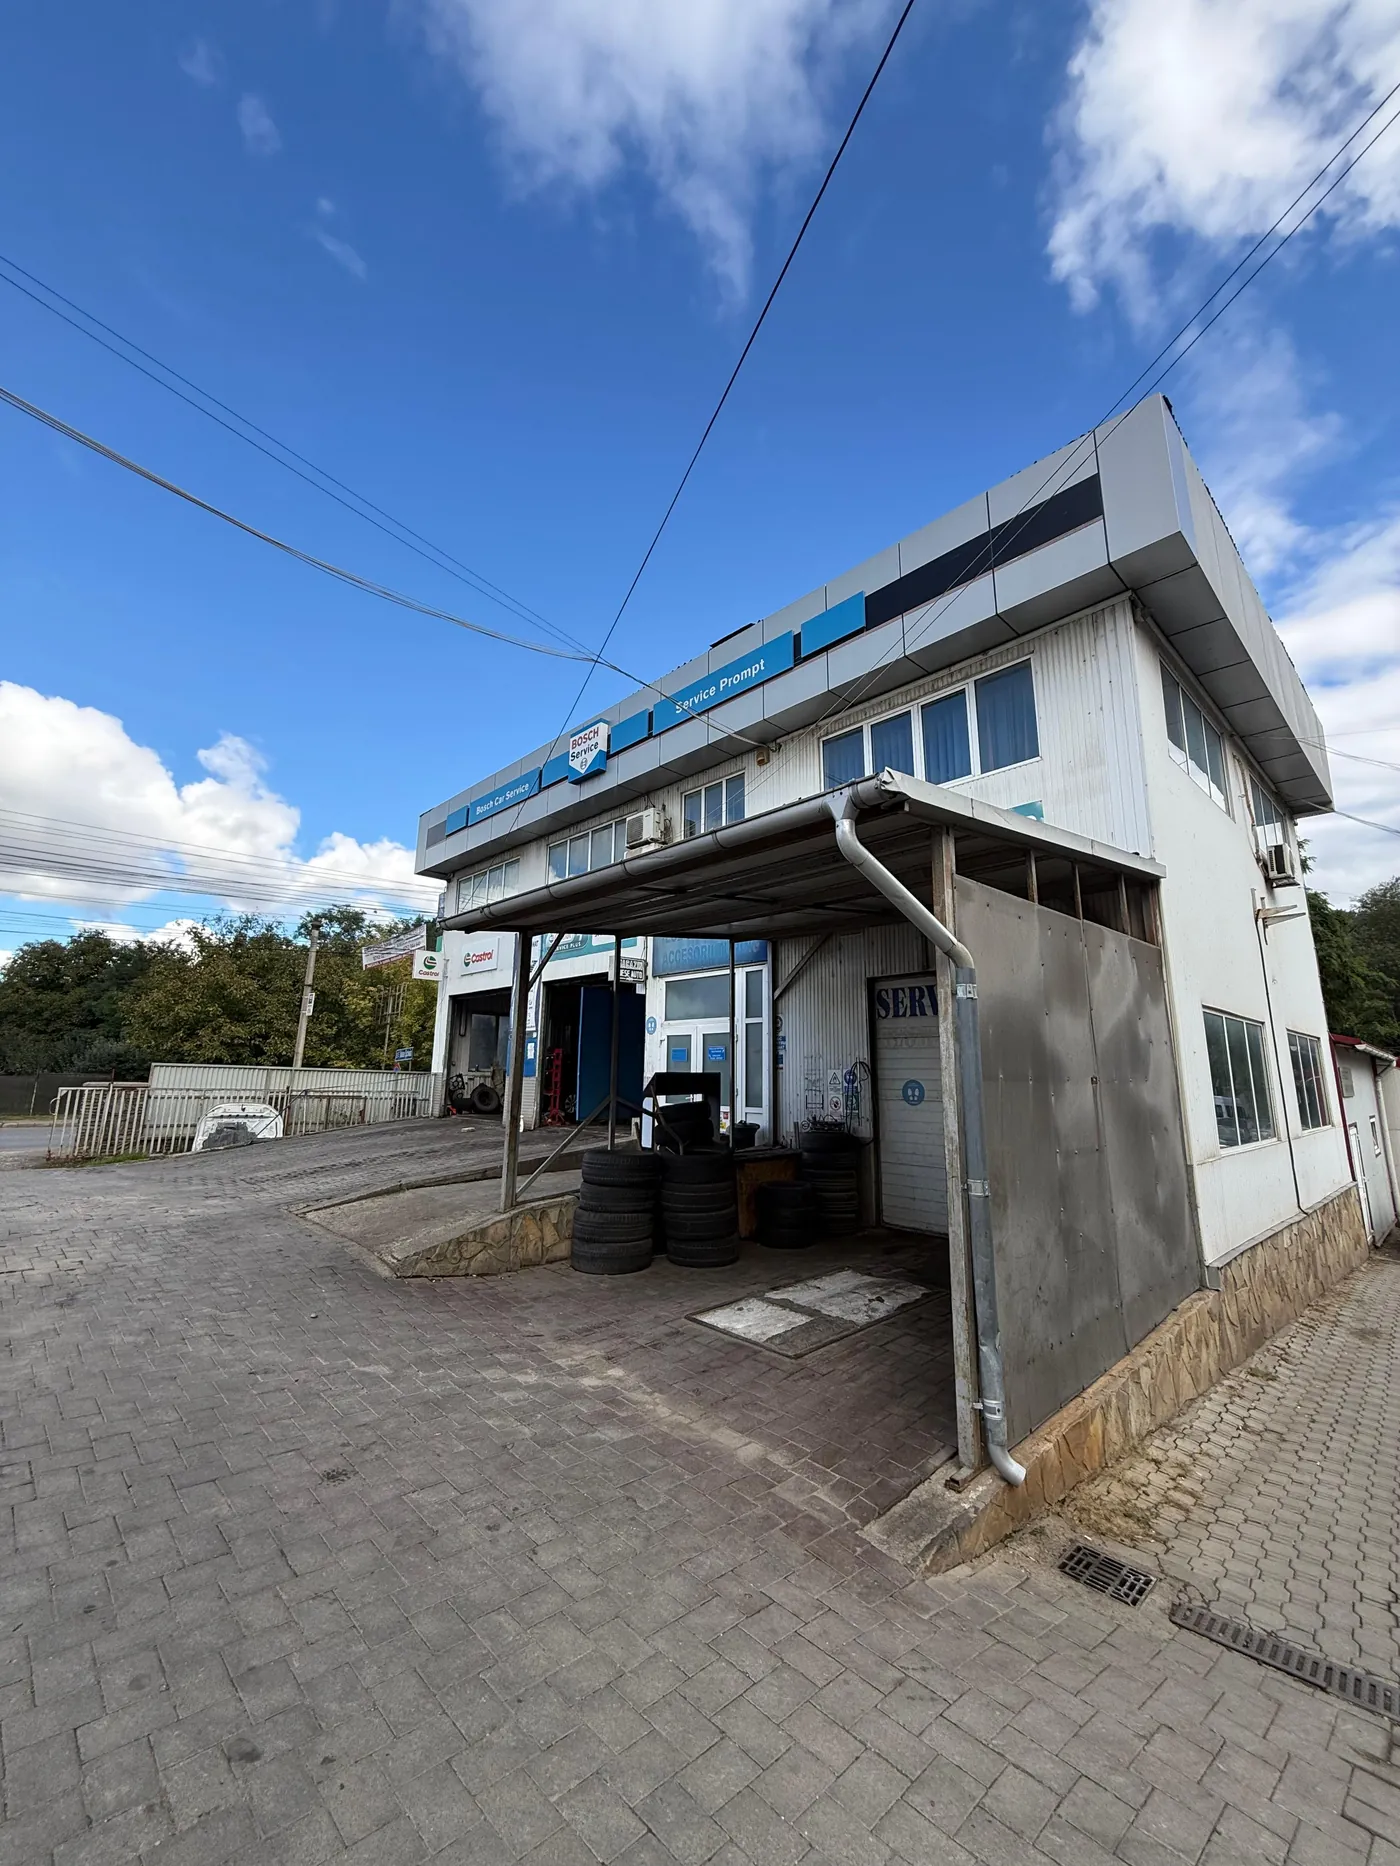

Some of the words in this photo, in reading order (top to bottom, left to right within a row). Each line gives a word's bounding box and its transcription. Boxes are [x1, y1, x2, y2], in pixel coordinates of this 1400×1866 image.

[675, 685, 716, 713] Service
[720, 658, 765, 691] Prompt
[571, 727, 599, 750] BOSCH
[570, 741, 599, 762] Service
[476, 800, 493, 815] Bosch
[494, 795, 505, 806] Car
[505, 783, 529, 800] Service
[471, 949, 494, 964] Castrol
[418, 969, 440, 977] Castrol
